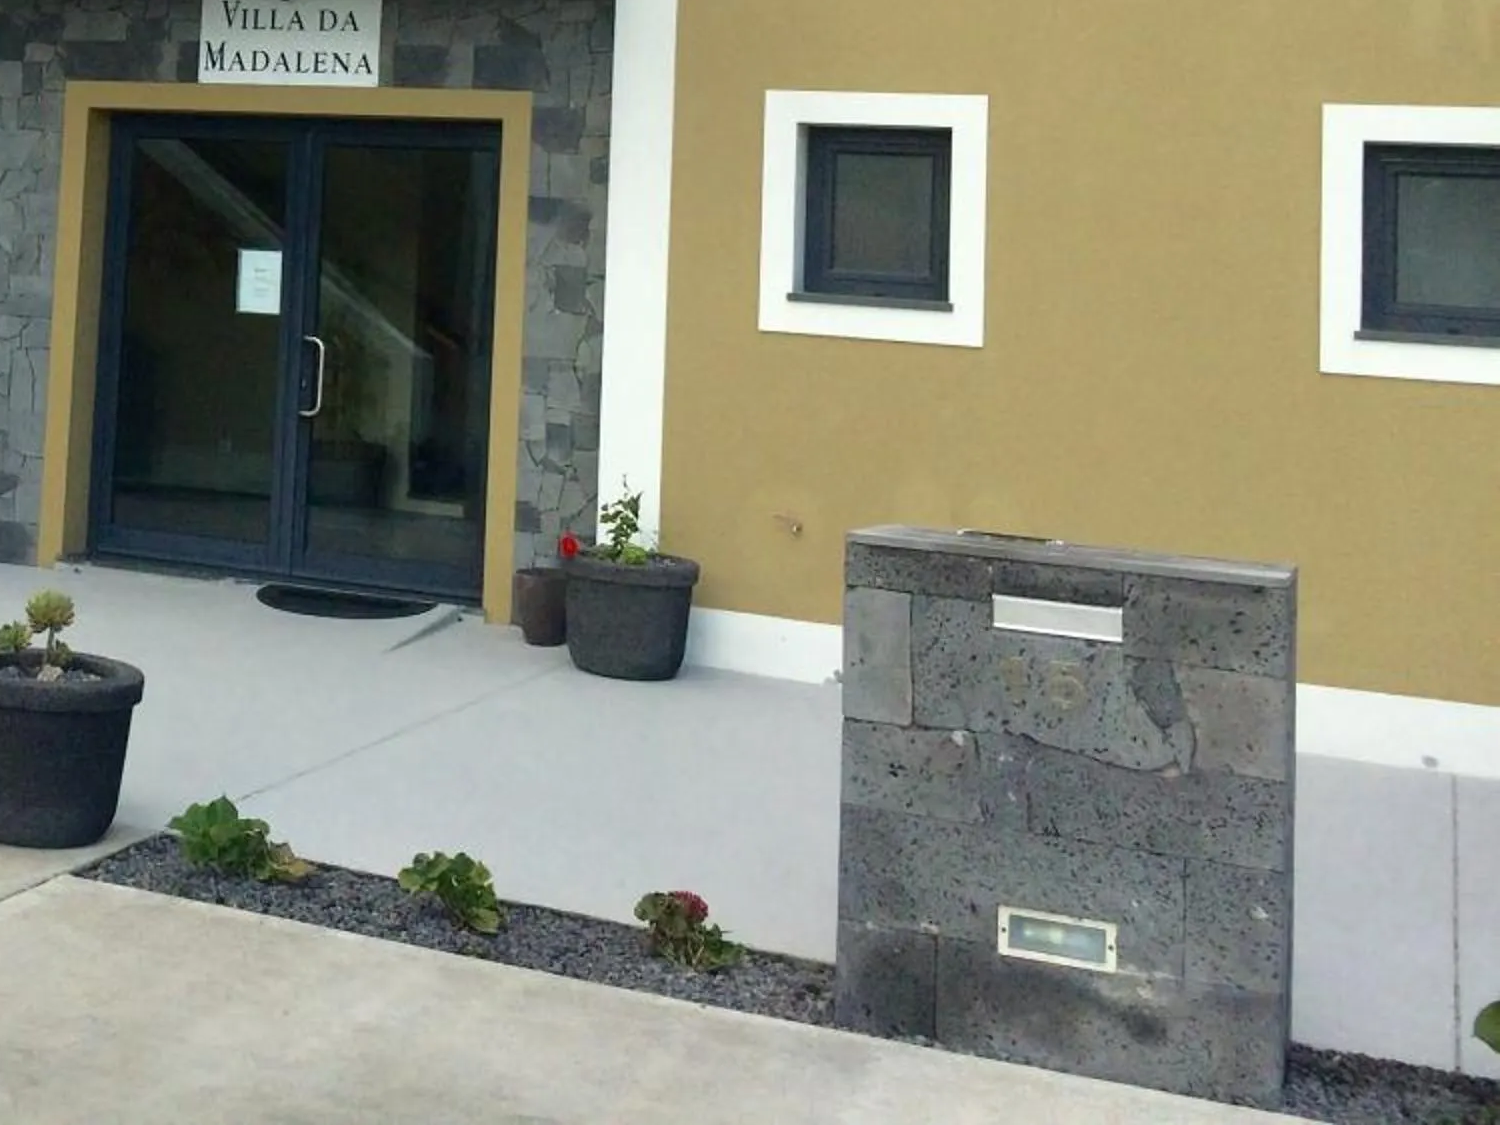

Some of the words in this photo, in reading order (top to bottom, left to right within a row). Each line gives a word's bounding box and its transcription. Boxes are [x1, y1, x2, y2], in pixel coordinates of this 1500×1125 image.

[222, 0, 304, 31] VILLA
[319, 8, 360, 32] DA
[204, 40, 373, 75] MADALENA
